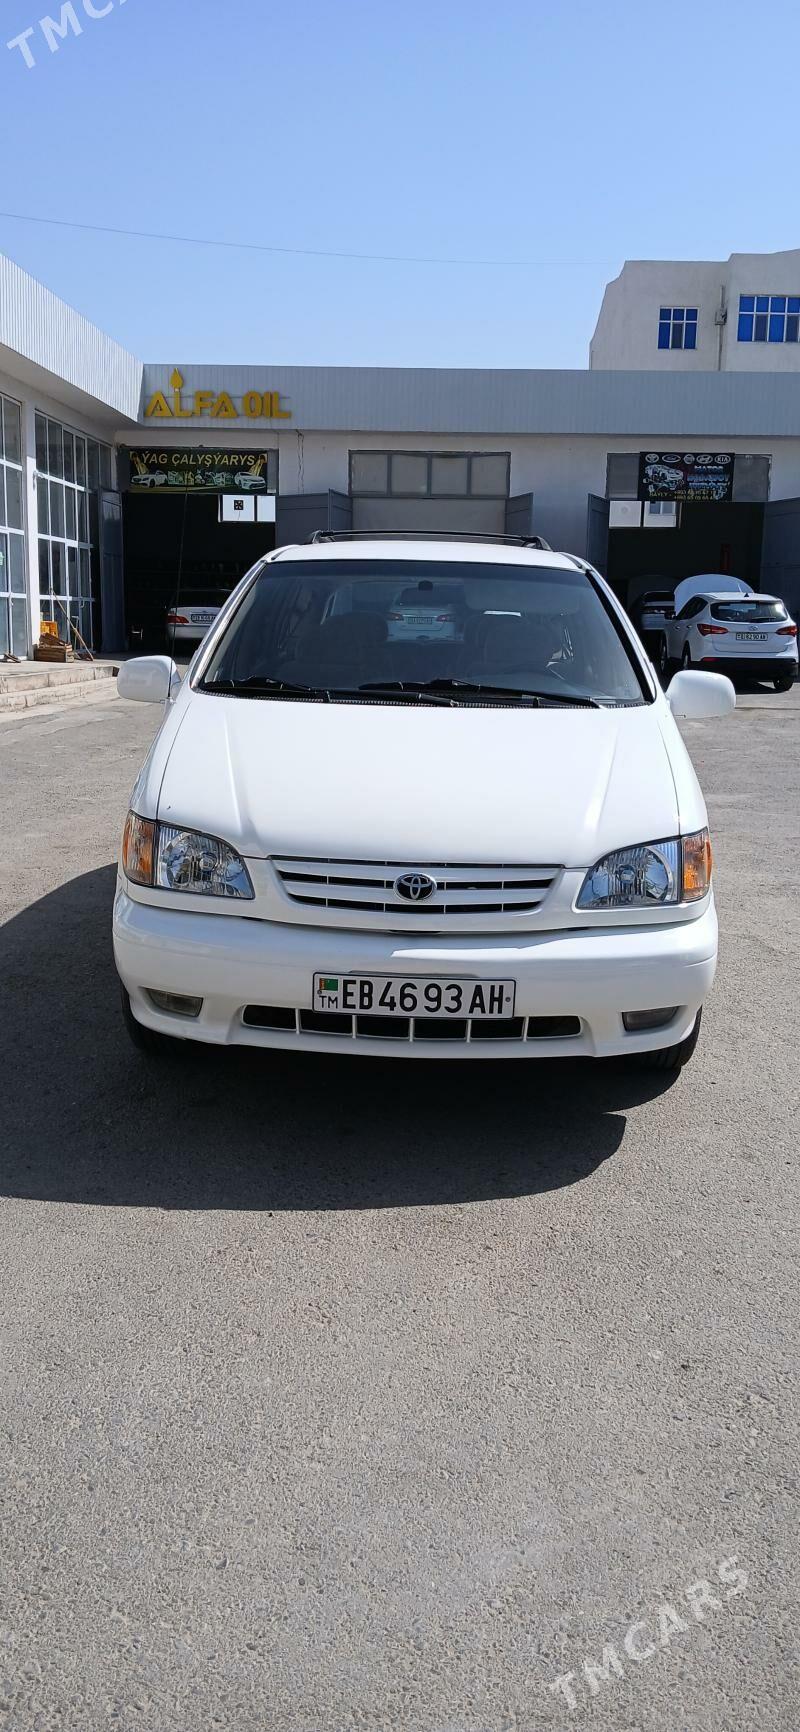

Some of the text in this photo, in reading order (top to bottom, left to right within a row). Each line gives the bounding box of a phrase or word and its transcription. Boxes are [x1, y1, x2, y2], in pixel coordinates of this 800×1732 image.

[146, 388, 291, 418] ALFA OIL
[142, 451, 168, 465] ÝAG
[319, 979, 504, 1015] TM EB4693AH
